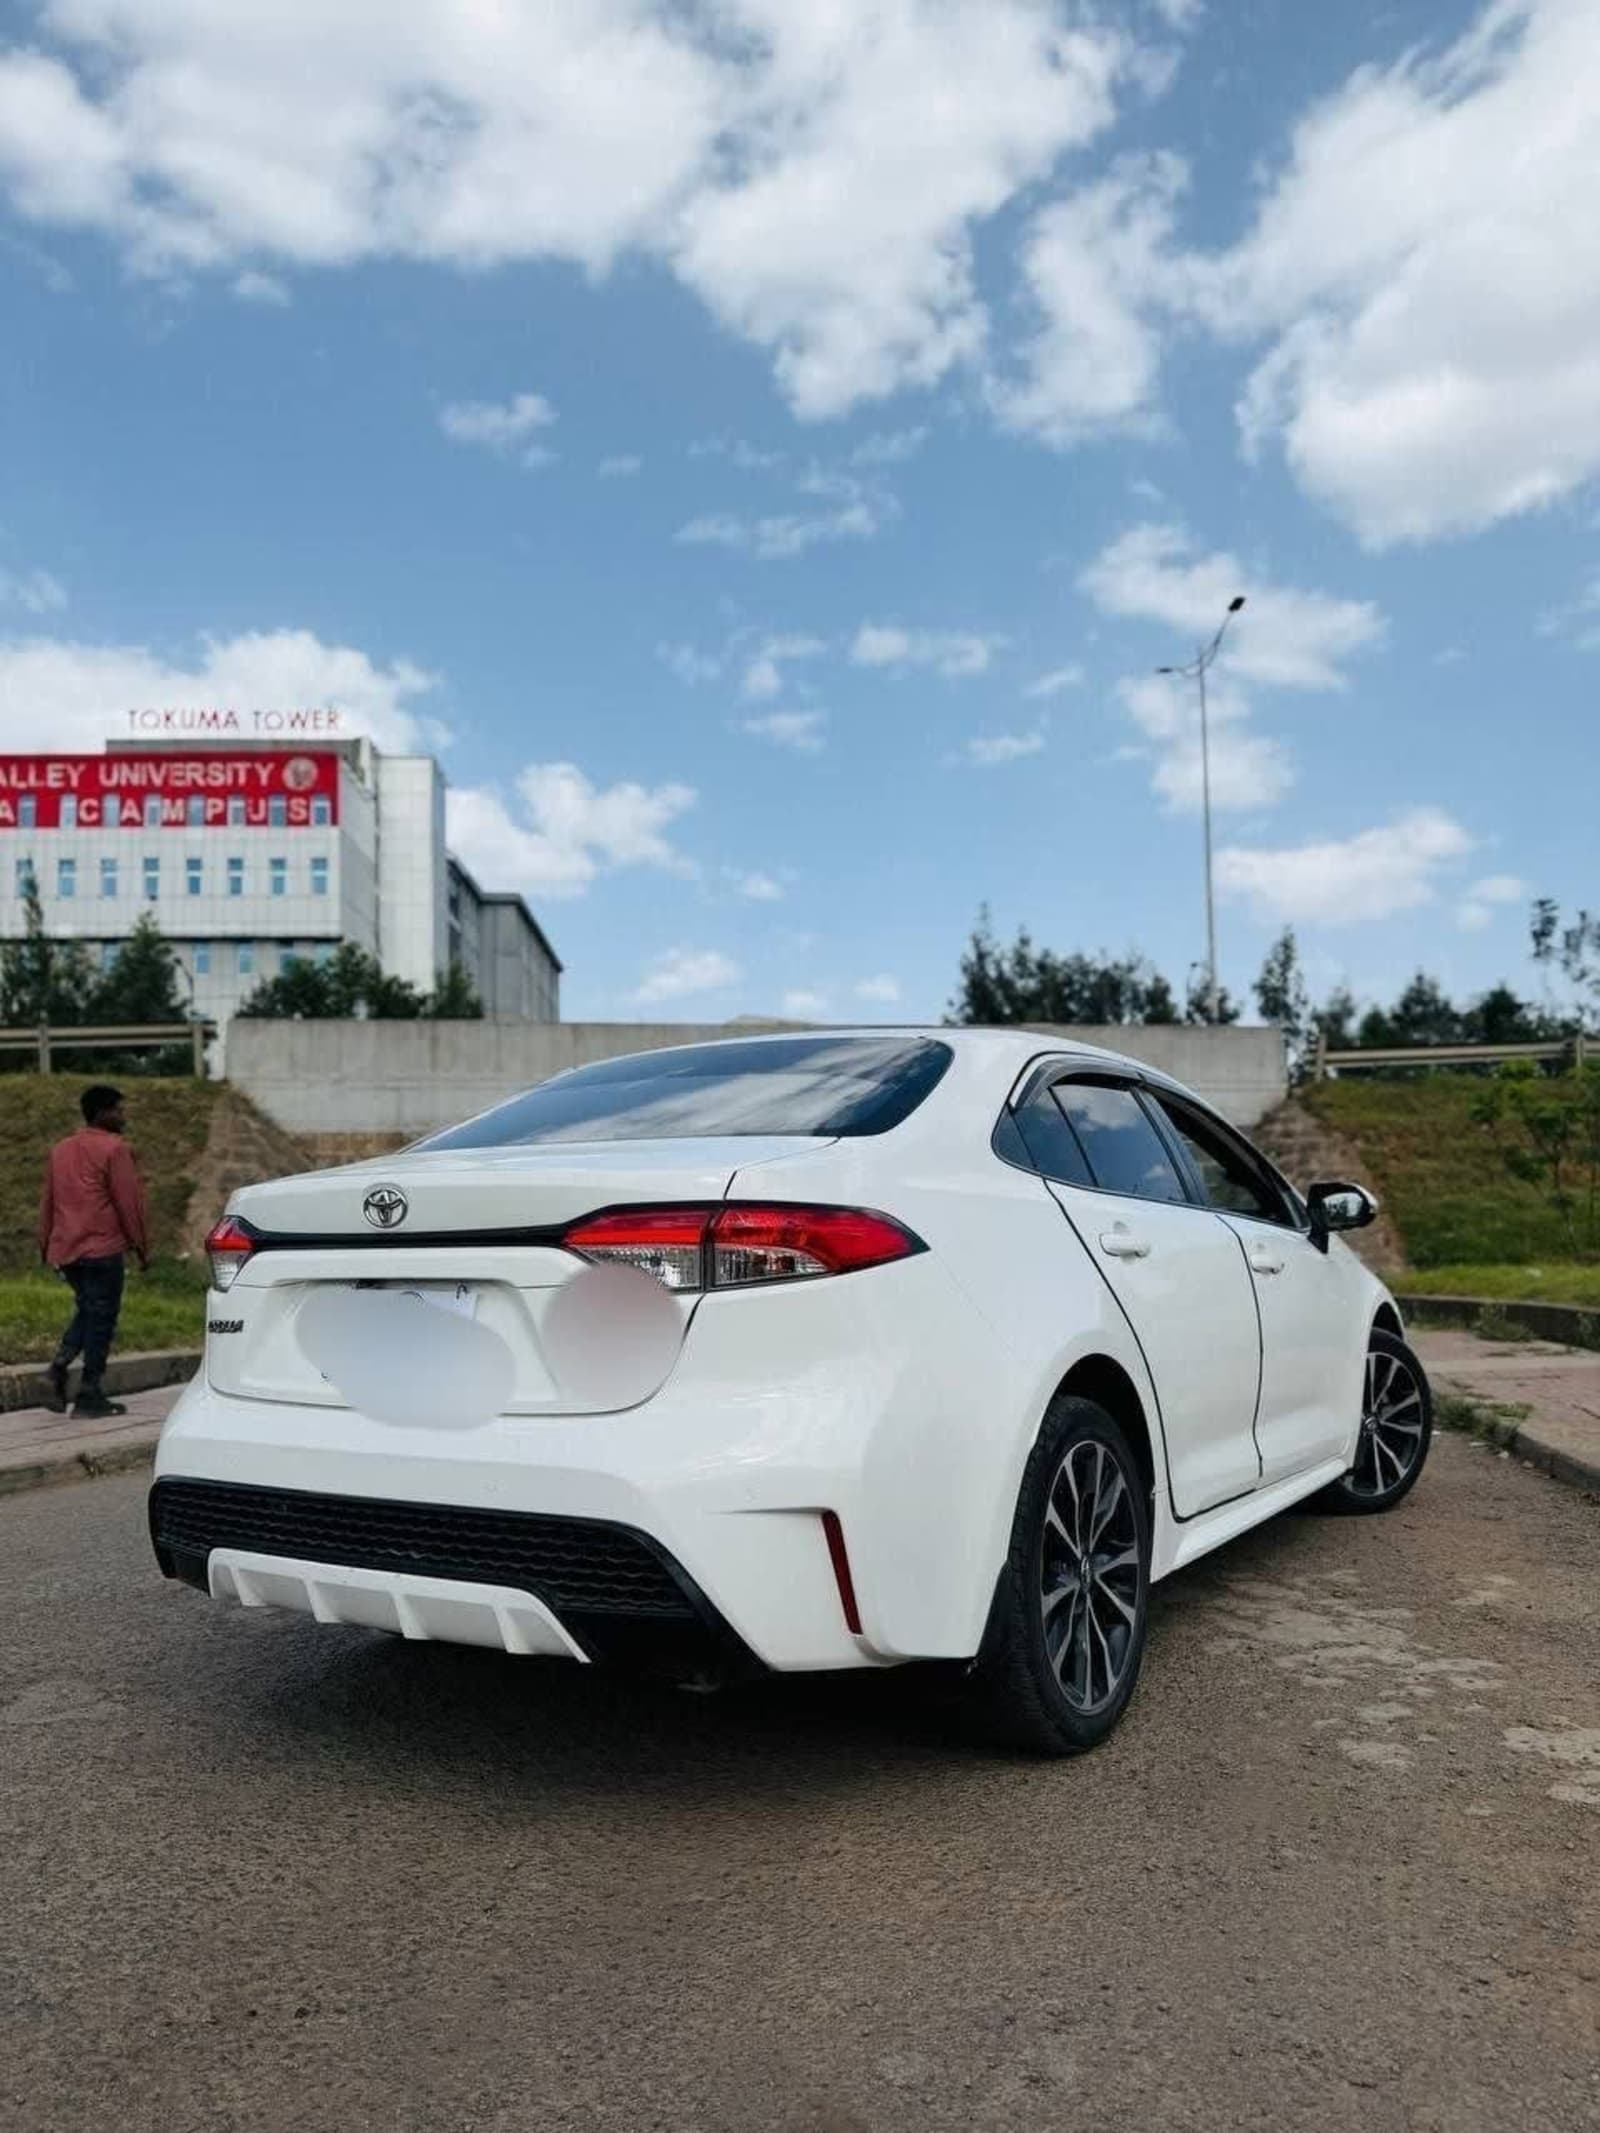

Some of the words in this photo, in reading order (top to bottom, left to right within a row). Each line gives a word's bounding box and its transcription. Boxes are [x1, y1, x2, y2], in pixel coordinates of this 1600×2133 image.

[128, 709, 239, 731] TOKUMA
[253, 708, 339, 731] TOWER
[98, 761, 275, 788] UNIVERSITY
[79, 796, 308, 823] CAMPUS
